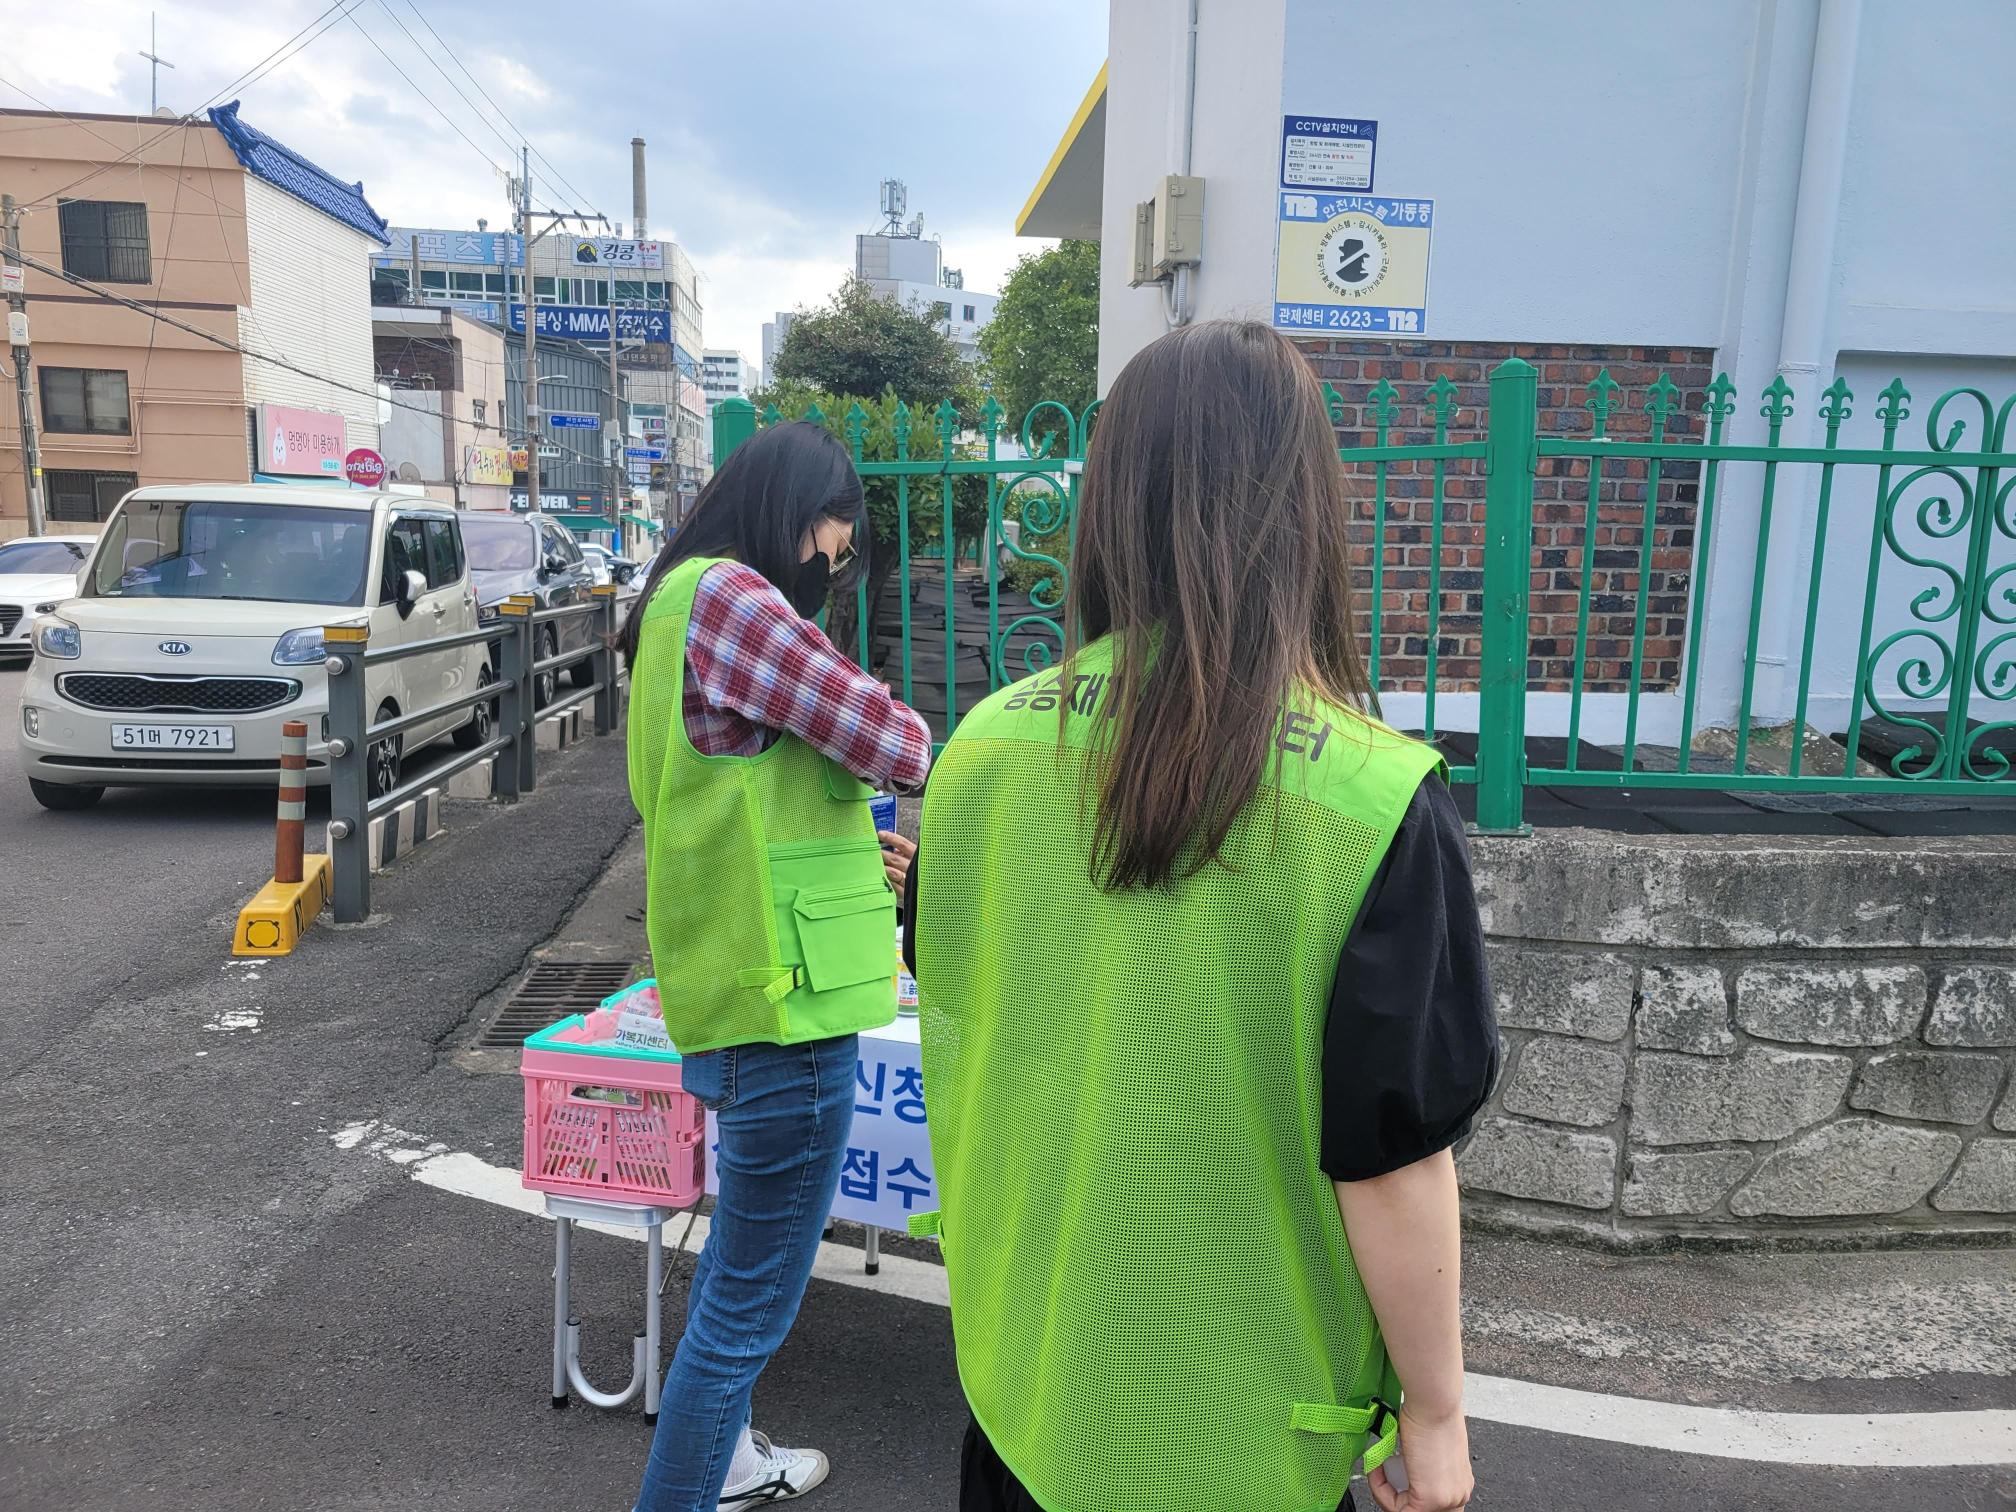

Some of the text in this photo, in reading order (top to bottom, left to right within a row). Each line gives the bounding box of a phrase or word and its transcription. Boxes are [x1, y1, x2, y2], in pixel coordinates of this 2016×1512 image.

[1296, 121, 1358, 134] CCTV설치안내
[1391, 202, 1431, 223] 가동중
[1358, 220, 1388, 249] 감시카메라
[603, 243, 635, 261] 킹콩
[1279, 307, 1323, 325] 관제센터
[162, 643, 186, 653] KIA
[123, 727, 221, 746] 51머 7921
[840, 1147, 932, 1210] 접수
